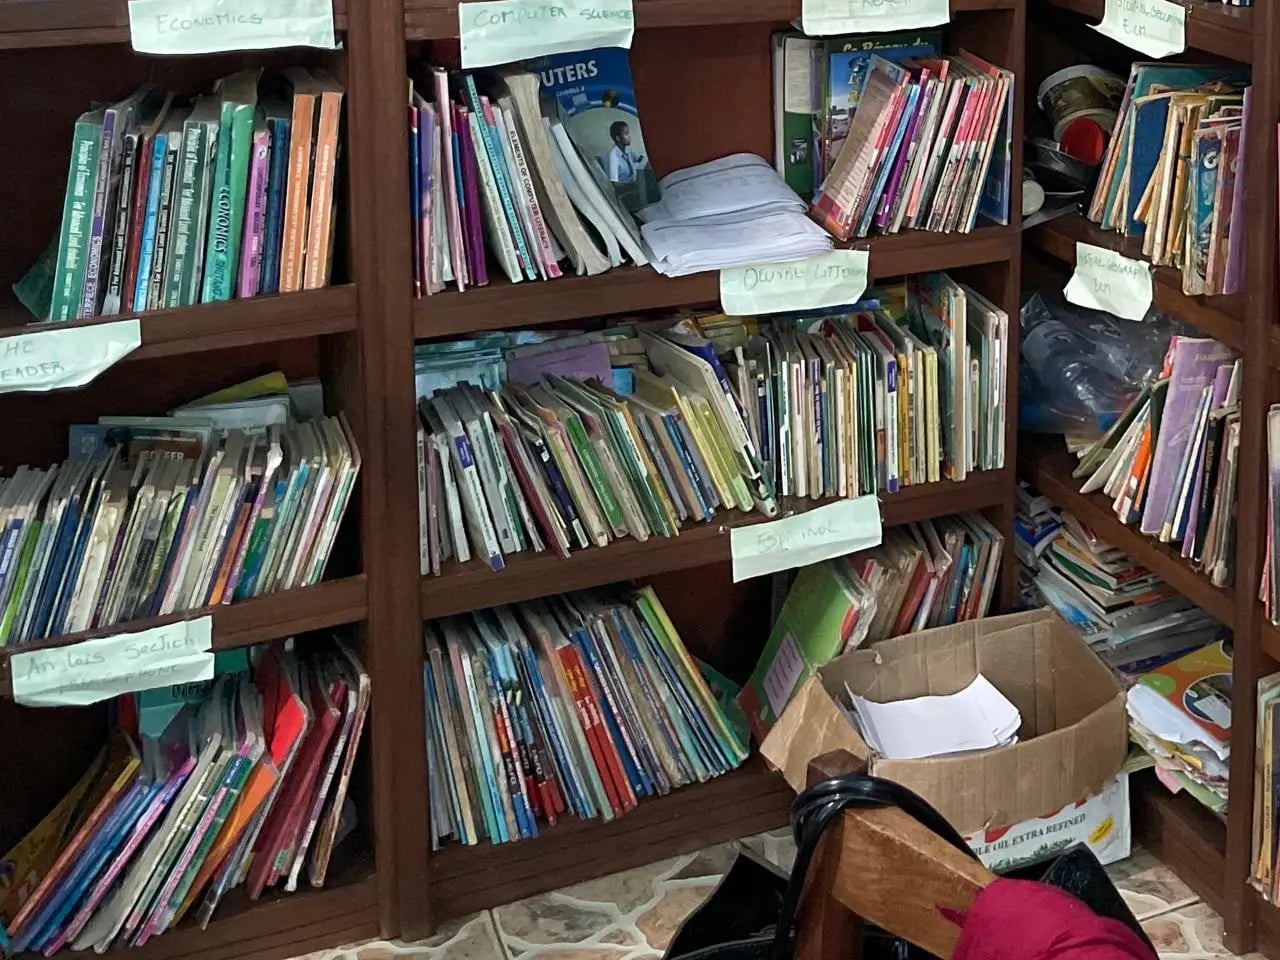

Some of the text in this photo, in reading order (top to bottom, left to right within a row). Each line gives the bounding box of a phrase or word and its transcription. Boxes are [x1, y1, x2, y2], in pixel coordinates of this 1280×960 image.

[156, 13, 264, 34] ECONOMICS
[473, 6, 567, 28] COMPUTER
[509, 129, 550, 249] ELEMENTS OF COMPUTER LITERACY
[87, 235, 102, 278] ECONOMICS
[1011, 828, 1043, 848] EXTRA
[1045, 813, 1087, 836] REFINED
